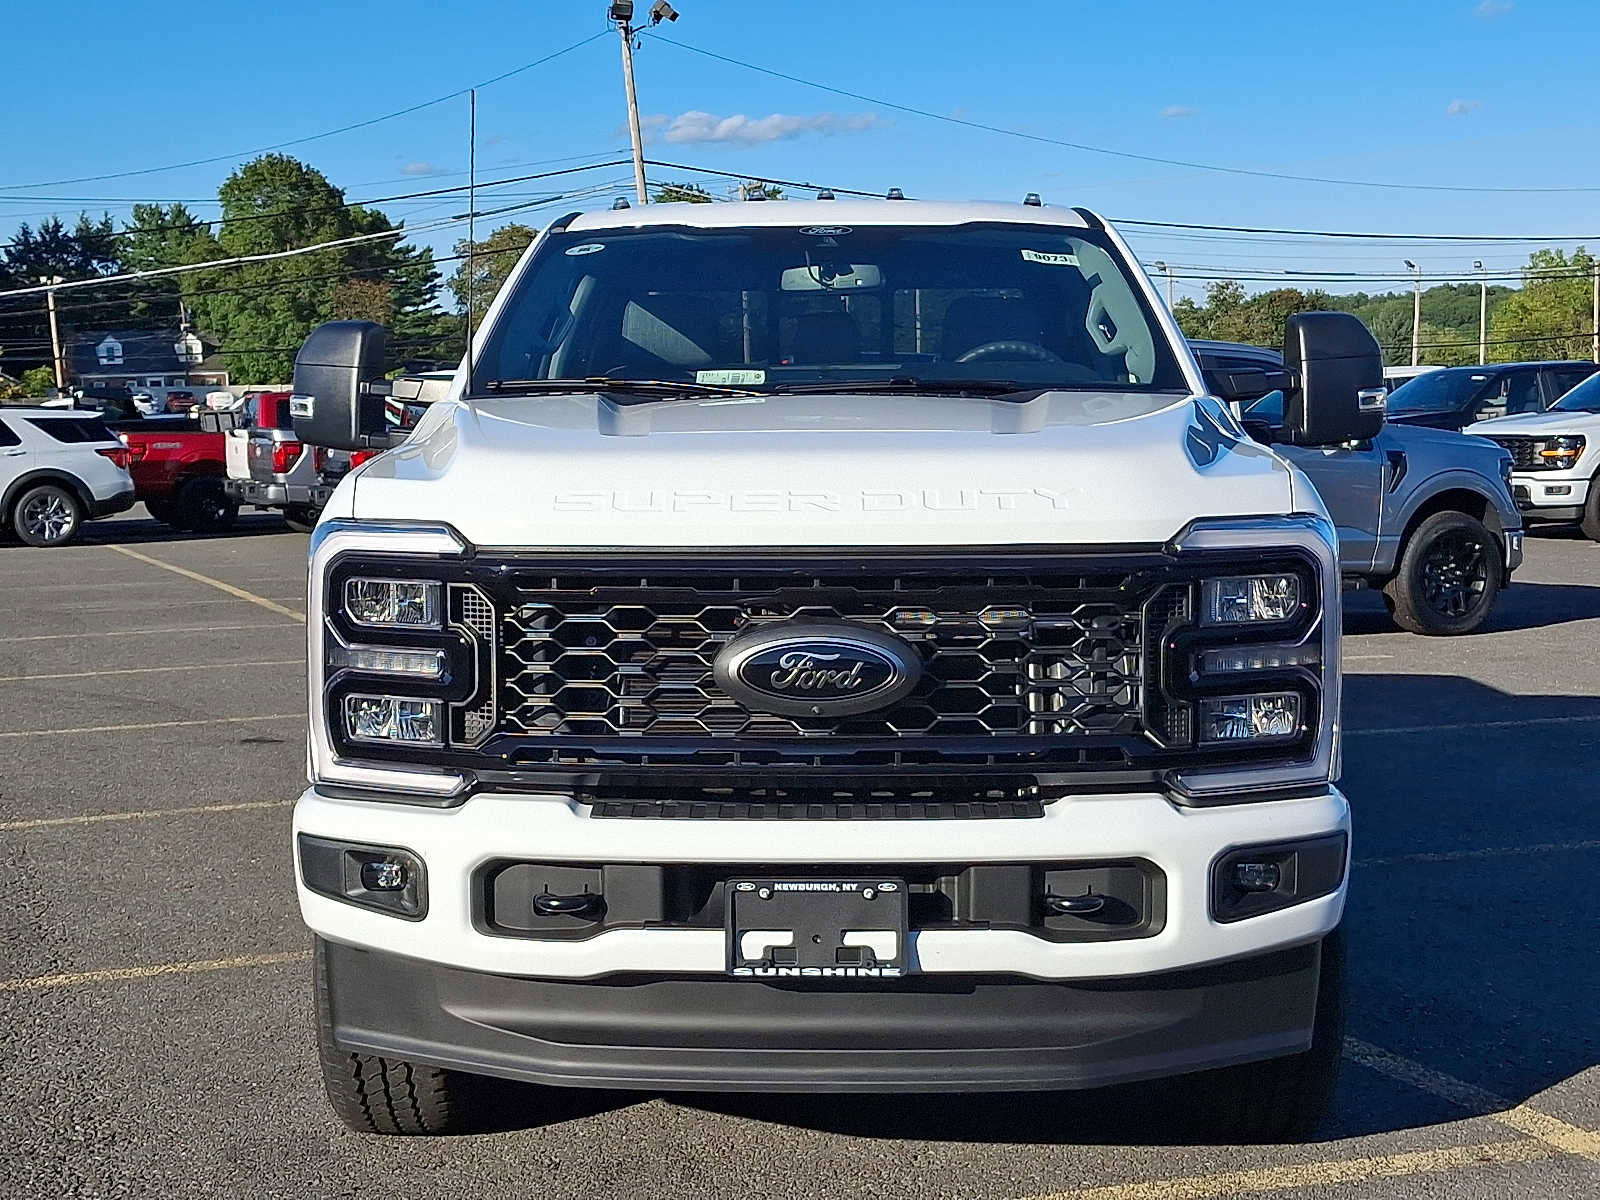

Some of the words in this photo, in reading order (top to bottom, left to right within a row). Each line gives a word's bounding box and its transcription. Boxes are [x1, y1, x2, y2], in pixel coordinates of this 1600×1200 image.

[553, 489, 841, 512] SUPER
[861, 487, 1080, 511] DUTY
[770, 651, 864, 689] Ford
[773, 883, 840, 892] NEWBURGH,
[842, 883, 858, 891] NY
[732, 967, 901, 977] SUNSHINE
